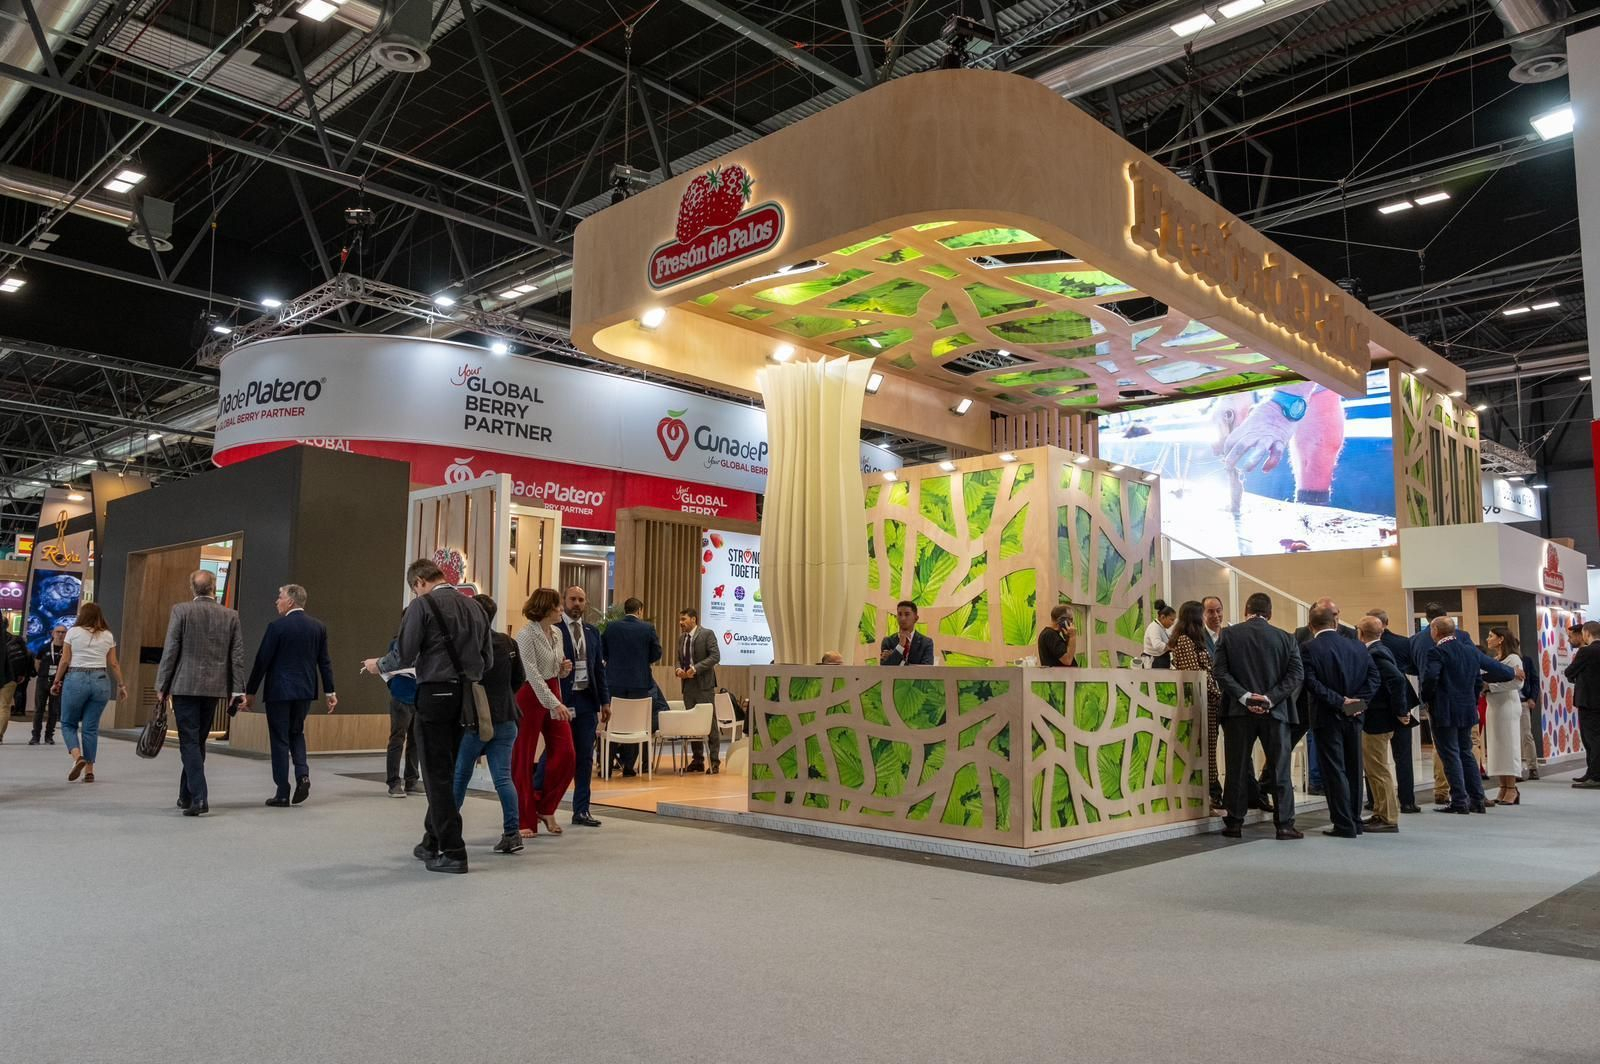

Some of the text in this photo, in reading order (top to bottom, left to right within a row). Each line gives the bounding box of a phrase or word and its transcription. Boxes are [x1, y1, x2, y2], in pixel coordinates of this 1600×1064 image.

[655, 219, 773, 280] Fresón de Palos
[451, 363, 482, 386] Your
[466, 376, 545, 404] GLOBAL
[237, 410, 260, 424] BERRY
[260, 407, 305, 419] PARTNER
[465, 395, 529, 419] BERRY
[464, 415, 552, 443] PARTNER
[694, 425, 769, 461] CunadeP
[720, 460, 749, 473] GLOBAL
[750, 466, 769, 476] BERR
[560, 505, 594, 516] PARTNER
[681, 492, 727, 507] GLOBAL
[730, 563, 760, 579] TOGETH
